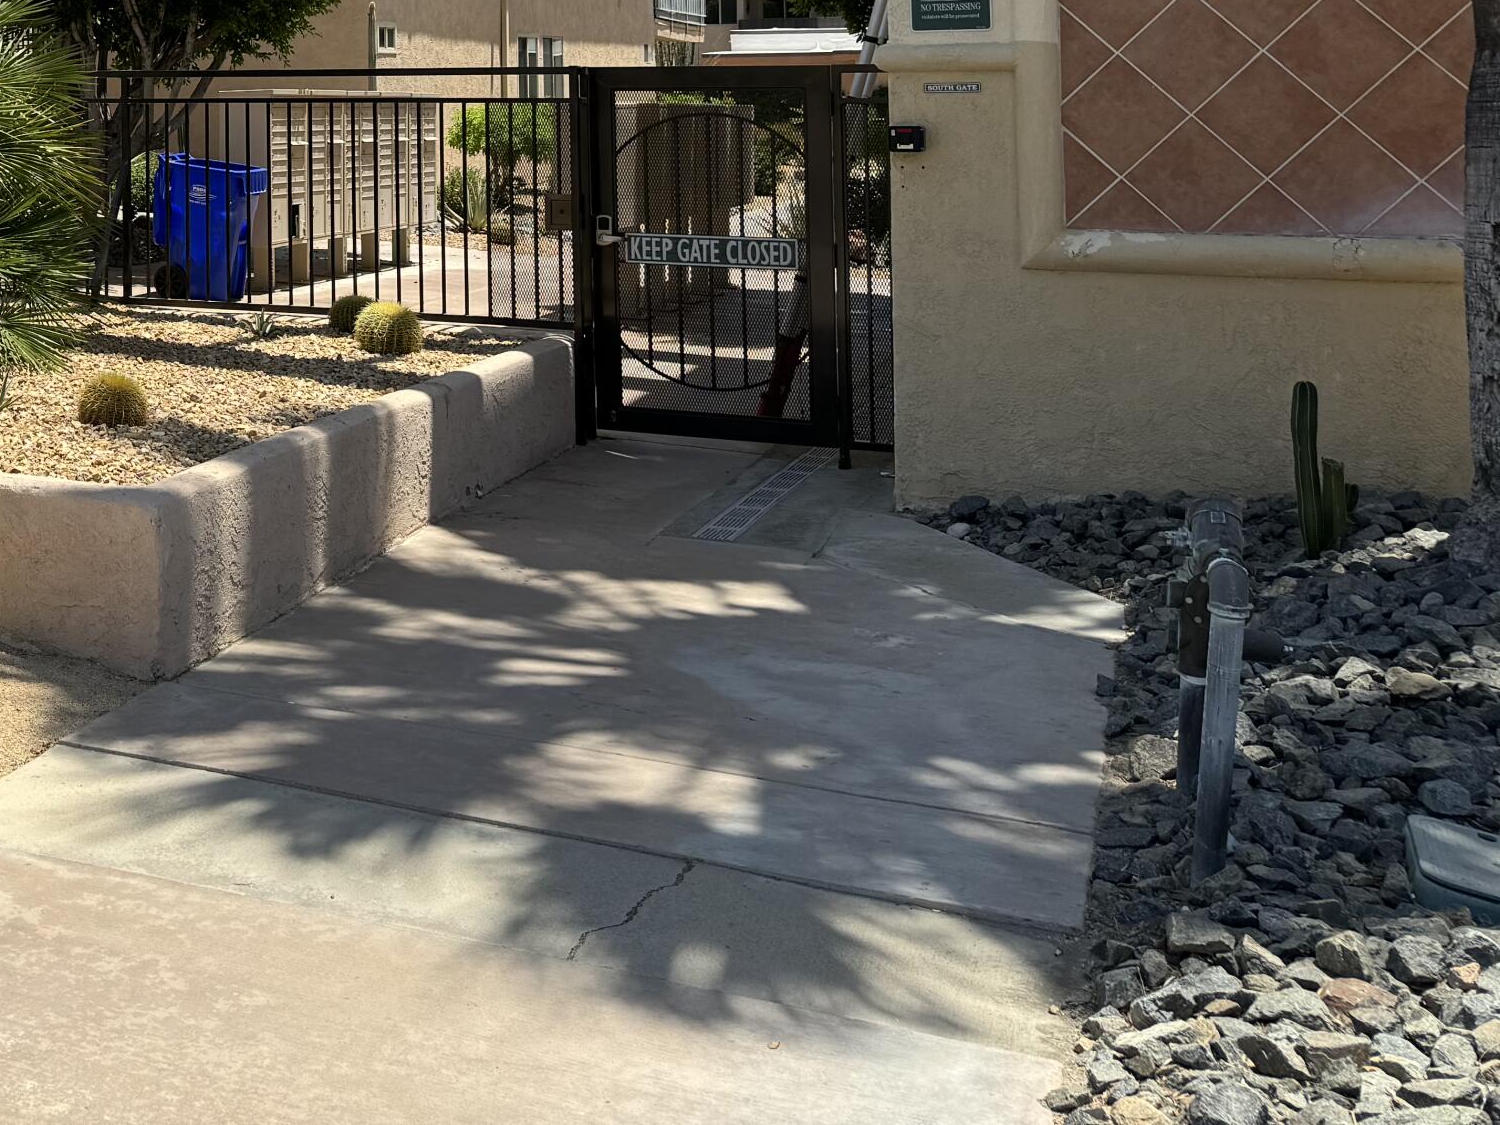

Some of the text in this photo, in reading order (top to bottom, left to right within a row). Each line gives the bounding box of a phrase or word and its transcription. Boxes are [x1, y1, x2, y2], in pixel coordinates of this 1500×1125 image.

[920, 2, 981, 12] NO TRESPASSING
[630, 236, 793, 266] KEEP GATE CLOSED
